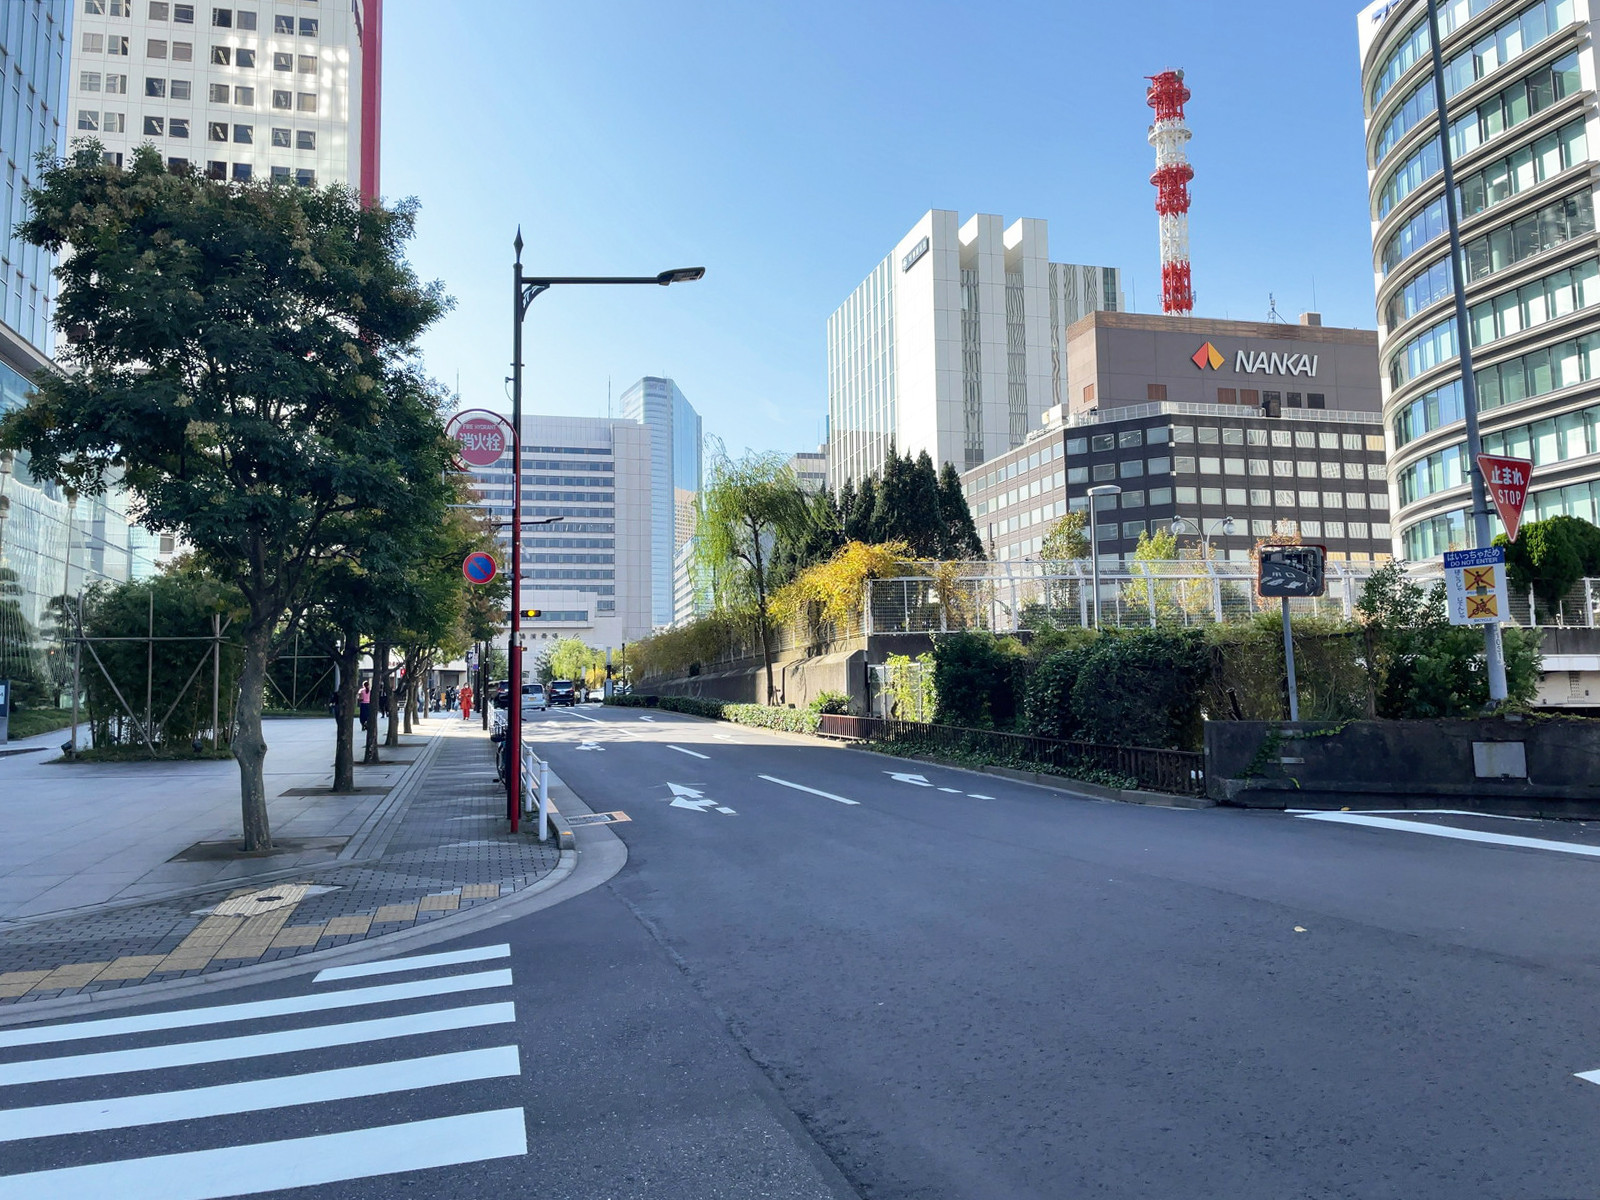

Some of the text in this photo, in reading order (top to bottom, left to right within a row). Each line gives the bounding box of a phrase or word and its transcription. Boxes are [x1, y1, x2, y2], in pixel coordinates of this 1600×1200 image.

[1235, 350, 1319, 377] NANKAI
[459, 432, 502, 451] 消火栓
[1491, 465, 1524, 486] 止まれ
[1498, 489, 1521, 506] STOP
[1447, 548, 1500, 561] はいっちゃだめ
[1475, 557, 1498, 565] ENTER
